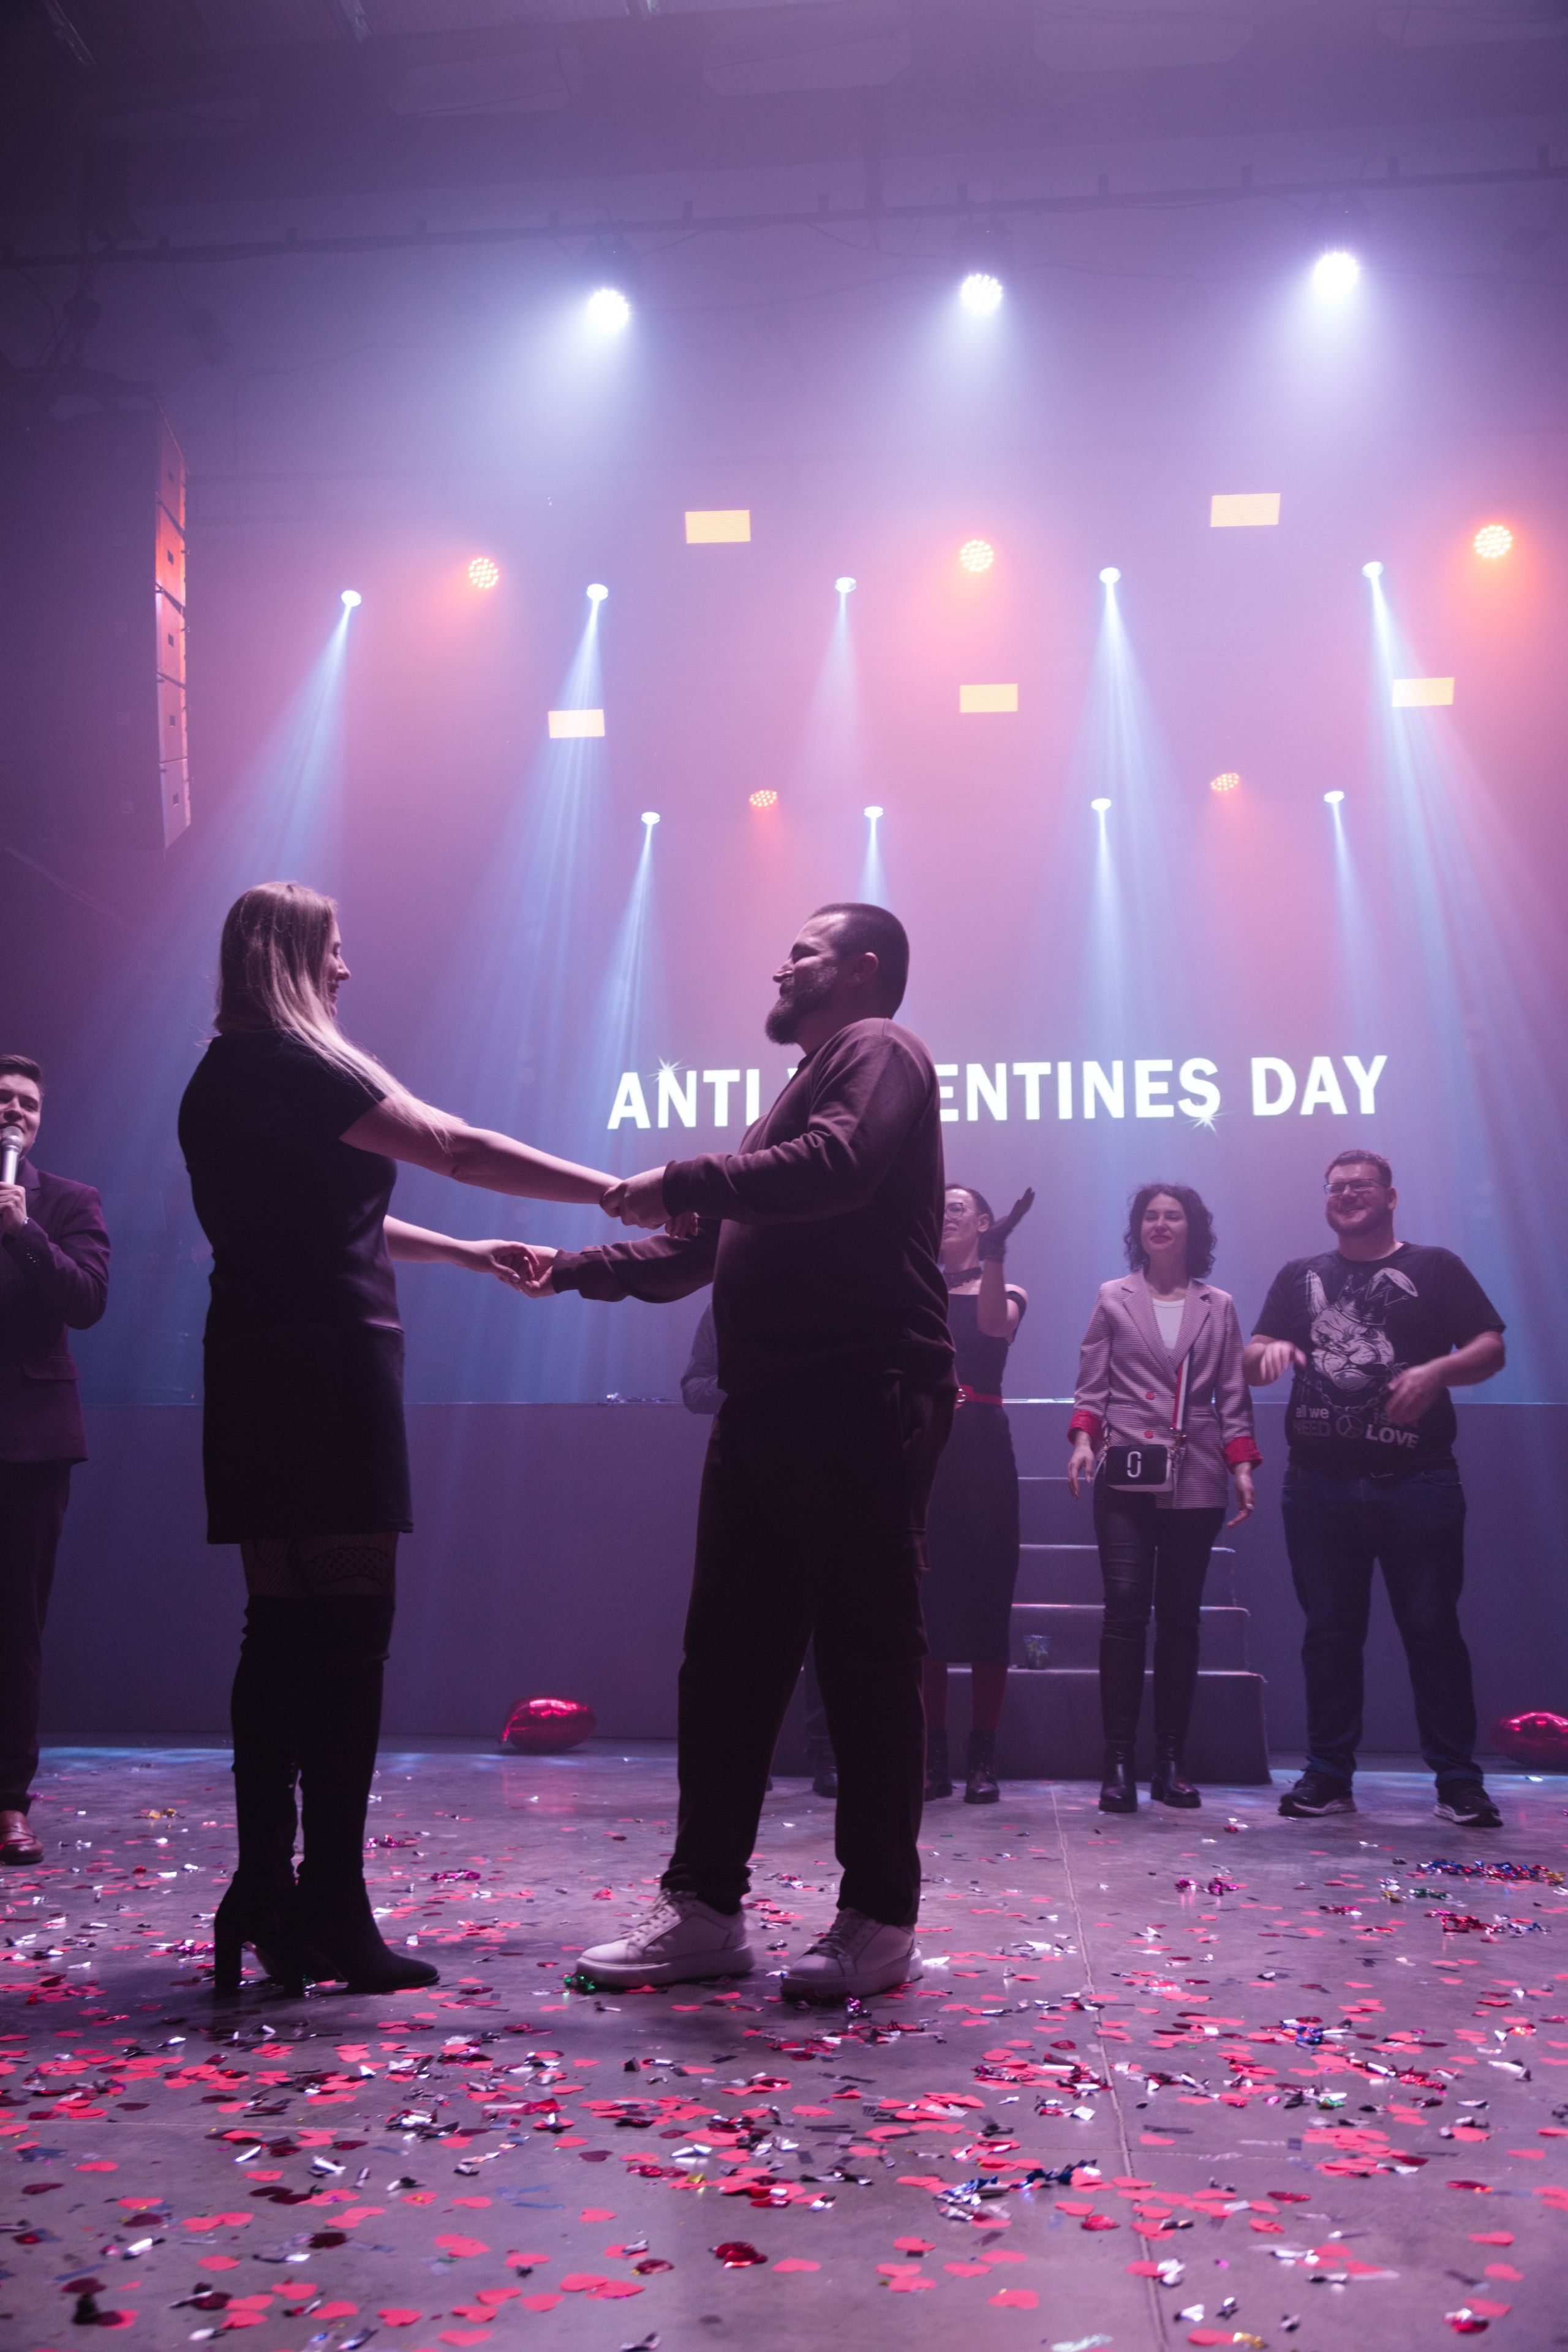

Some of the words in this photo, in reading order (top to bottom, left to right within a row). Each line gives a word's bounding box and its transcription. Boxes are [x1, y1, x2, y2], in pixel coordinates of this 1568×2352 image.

[607, 1067, 760, 1129] ANTI
[1251, 1055, 1388, 1116] DAY
[1309, 1408, 1330, 1420] we
[1365, 1424, 1420, 1449] LOVE
